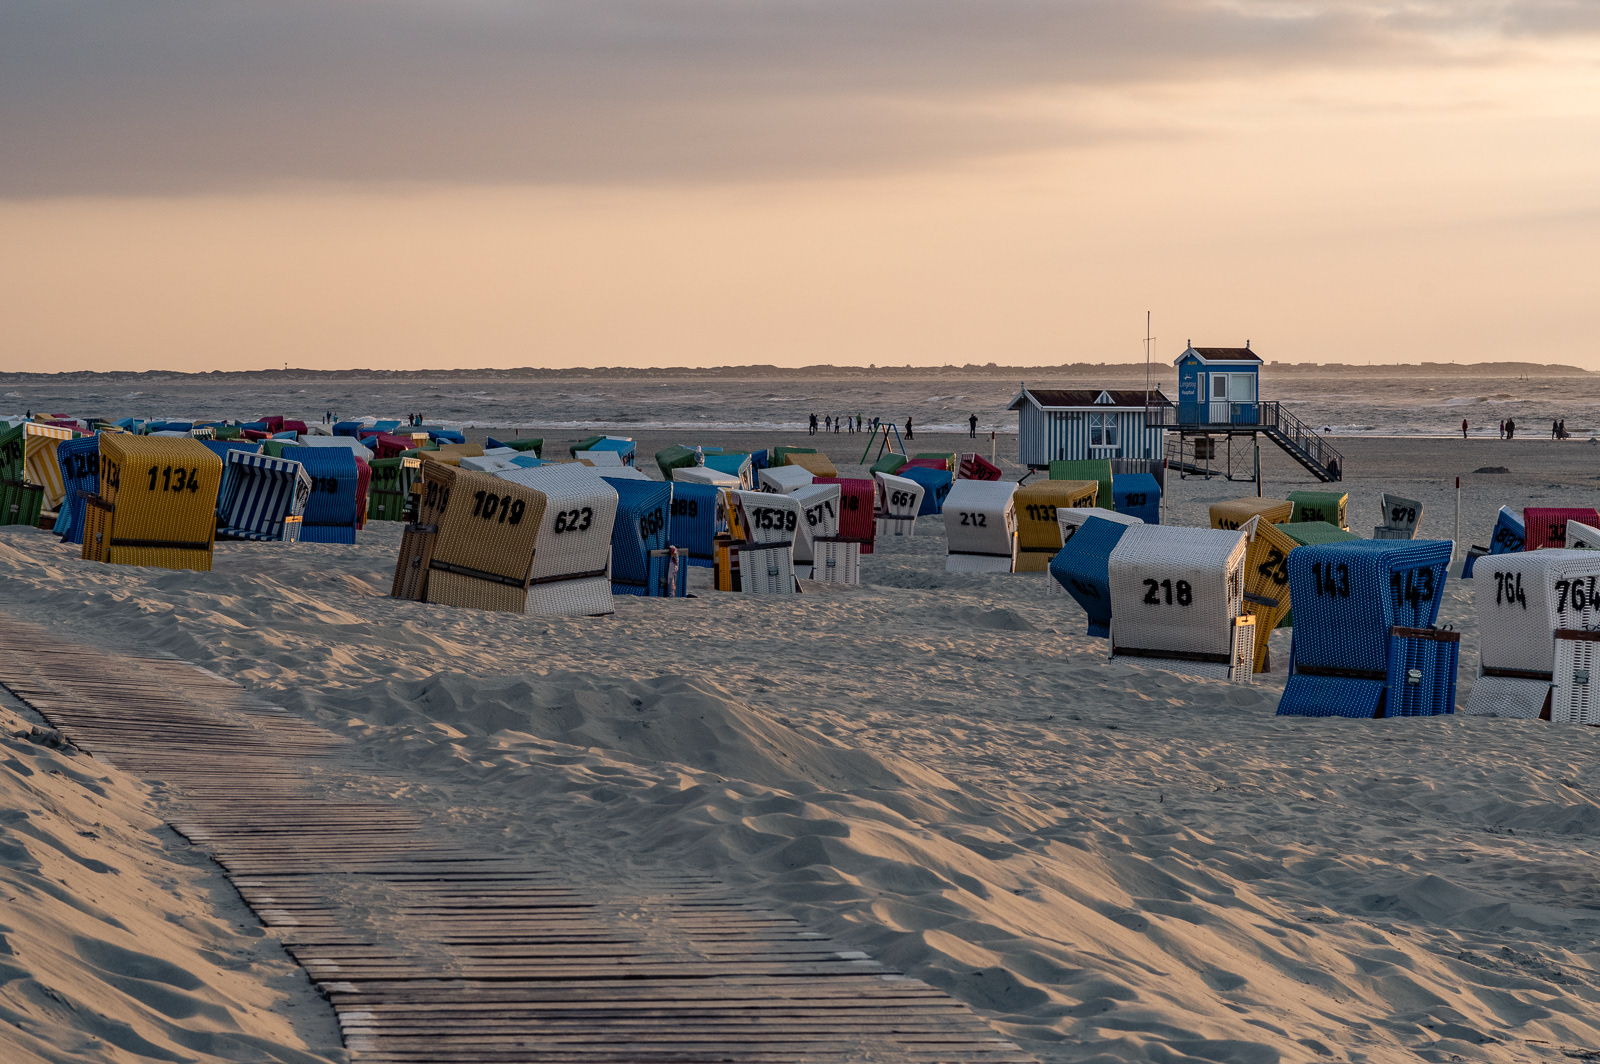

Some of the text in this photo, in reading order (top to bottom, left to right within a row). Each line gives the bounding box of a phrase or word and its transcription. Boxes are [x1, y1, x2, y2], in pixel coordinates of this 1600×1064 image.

[148, 466, 198, 493] 1134
[424, 480, 450, 513] 1019
[474, 491, 525, 525] 1019
[892, 491, 916, 508] 661
[1125, 493, 1147, 506] 103
[555, 507, 593, 534] 623
[753, 508, 797, 532] 1539
[807, 501, 834, 527] 671
[960, 512, 987, 528] 212
[1026, 504, 1057, 521] 1133
[1391, 507, 1416, 524] 978
[1143, 579, 1192, 606] 218
[1312, 562, 1349, 598] 143
[1390, 567, 1434, 609] 143
[1494, 571, 1526, 610] 764
[1555, 576, 1600, 613] 764
